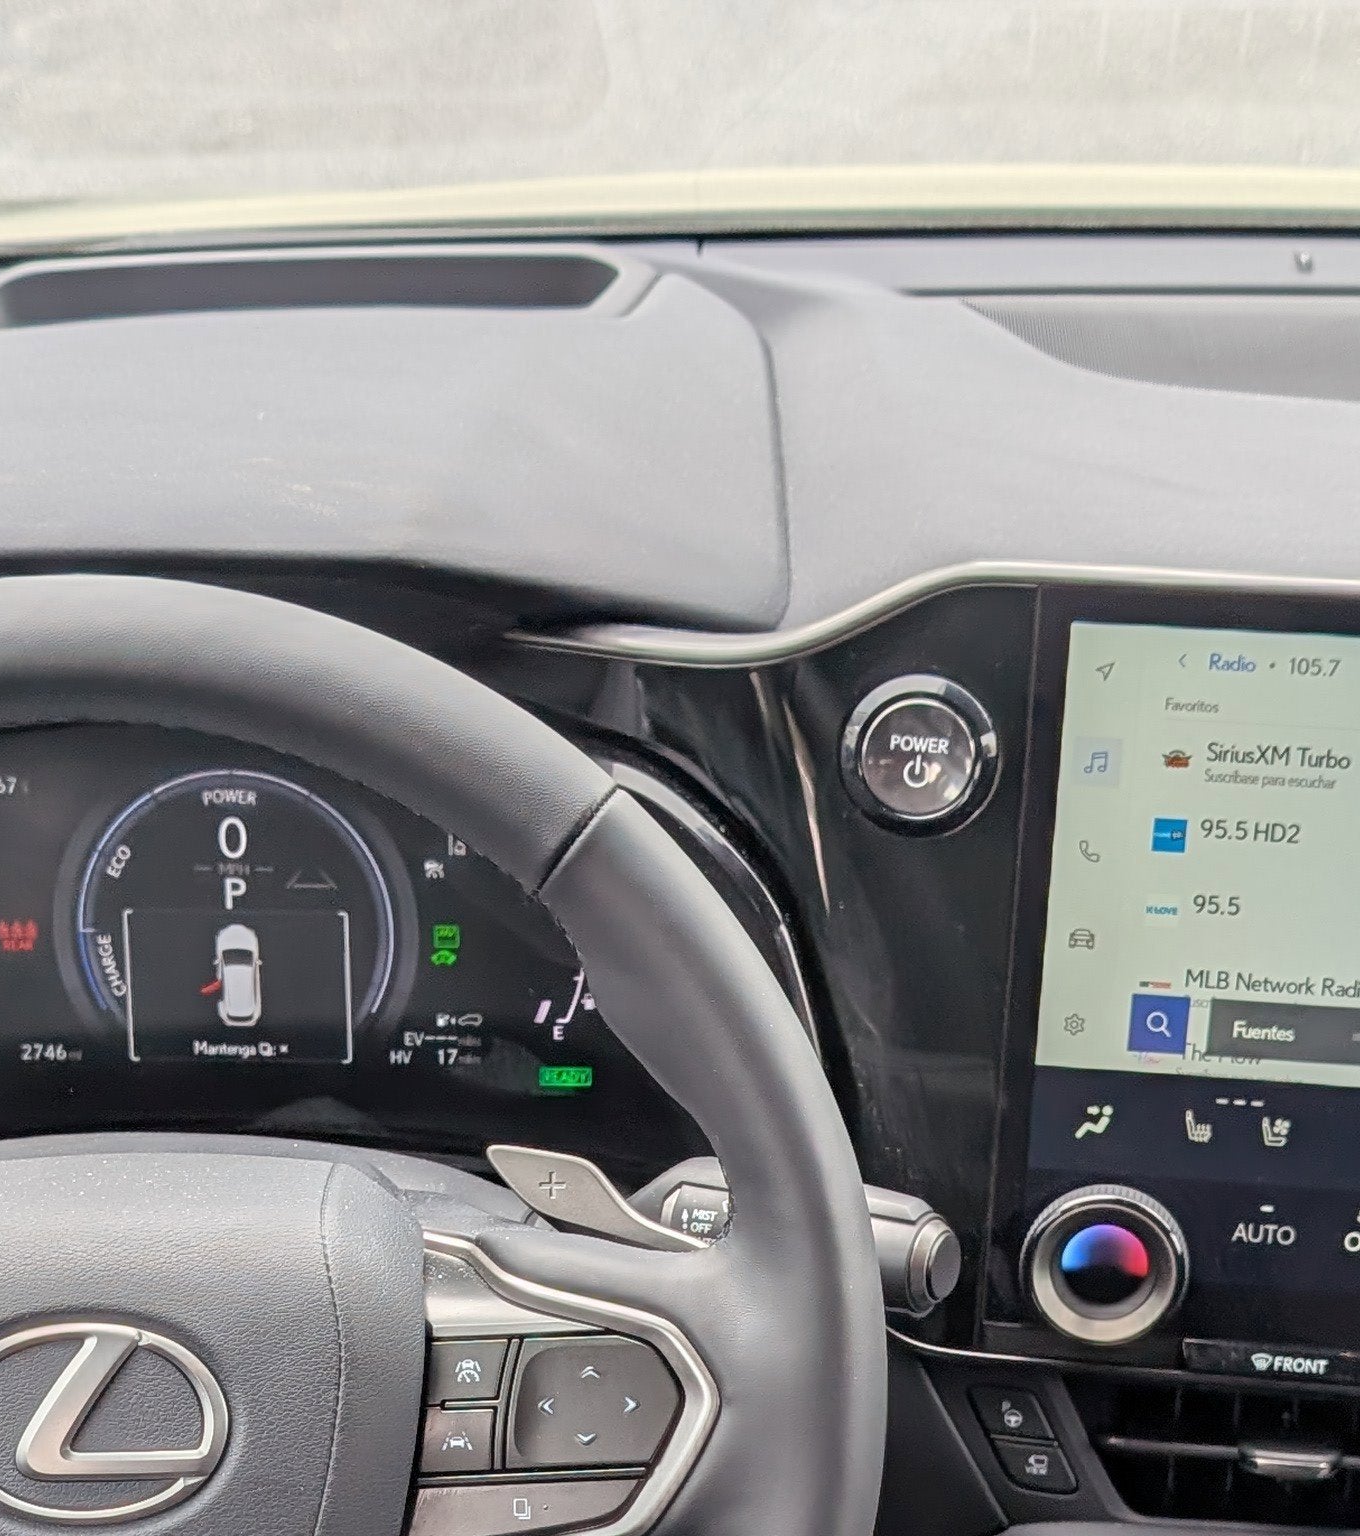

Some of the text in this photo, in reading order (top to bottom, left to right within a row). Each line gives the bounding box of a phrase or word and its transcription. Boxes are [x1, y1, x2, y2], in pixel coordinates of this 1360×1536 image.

[1209, 654, 1341, 677] Radio 105.7
[1165, 697, 1219, 714] Favoritos
[890, 733, 949, 755] POWER
[1207, 742, 1351, 770] SiriusXM Turbo
[202, 789, 257, 806] POWER
[217, 816, 248, 860] 0
[1200, 819, 1247, 841] 95.5
[1253, 823, 1301, 844] HD2
[106, 845, 132, 879] ECO
[223, 877, 247, 910] P
[1193, 894, 1240, 916] 95.5
[96, 934, 127, 998] CHARGE
[1185, 969, 1229, 990] MLB
[1236, 973, 1315, 996] Network
[553, 1025, 564, 1041] E
[1233, 1020, 1295, 1042] Fuentes
[20, 1044, 68, 1061] 2746
[193, 1040, 257, 1057] Mantenga
[390, 1050, 412, 1064] HV
[438, 1049, 458, 1065] 17
[692, 1208, 718, 1222] MIST
[690, 1222, 713, 1234] OFF
[1231, 1222, 1296, 1247] AUTO
[1273, 1355, 1328, 1376] FRONT
